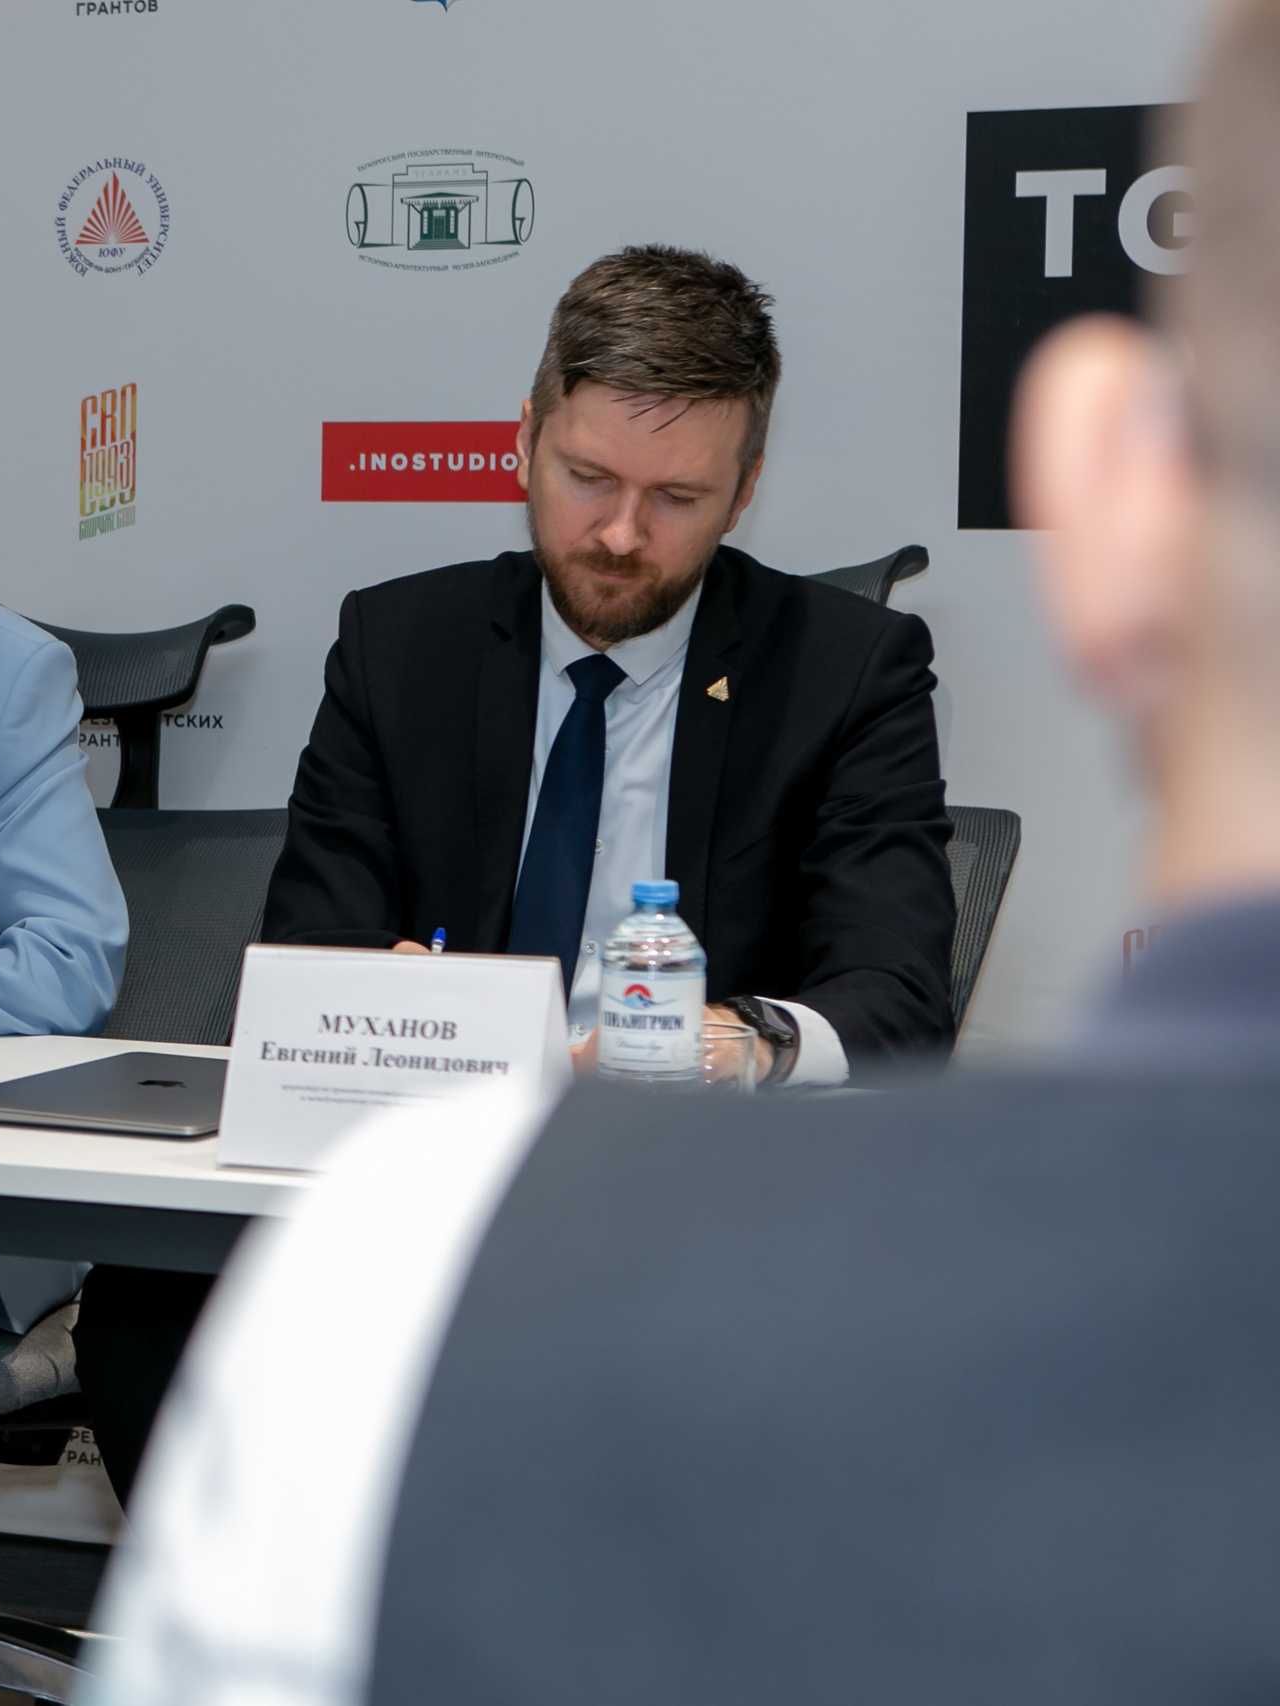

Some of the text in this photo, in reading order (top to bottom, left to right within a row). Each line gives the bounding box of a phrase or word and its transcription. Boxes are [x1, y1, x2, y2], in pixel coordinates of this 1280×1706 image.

[76, 0, 158, 16] ГРАНТОВ
[54, 157, 170, 277] ЮЖНЫЙ ФЕДЕРАЛЬНЫЙ УНИВЕРСИТЕТ
[98, 247, 126, 258] ЮФУ
[318, 1013, 458, 1041] МУХАНОВ
[260, 1041, 509, 1076] Евгений Леонидович
